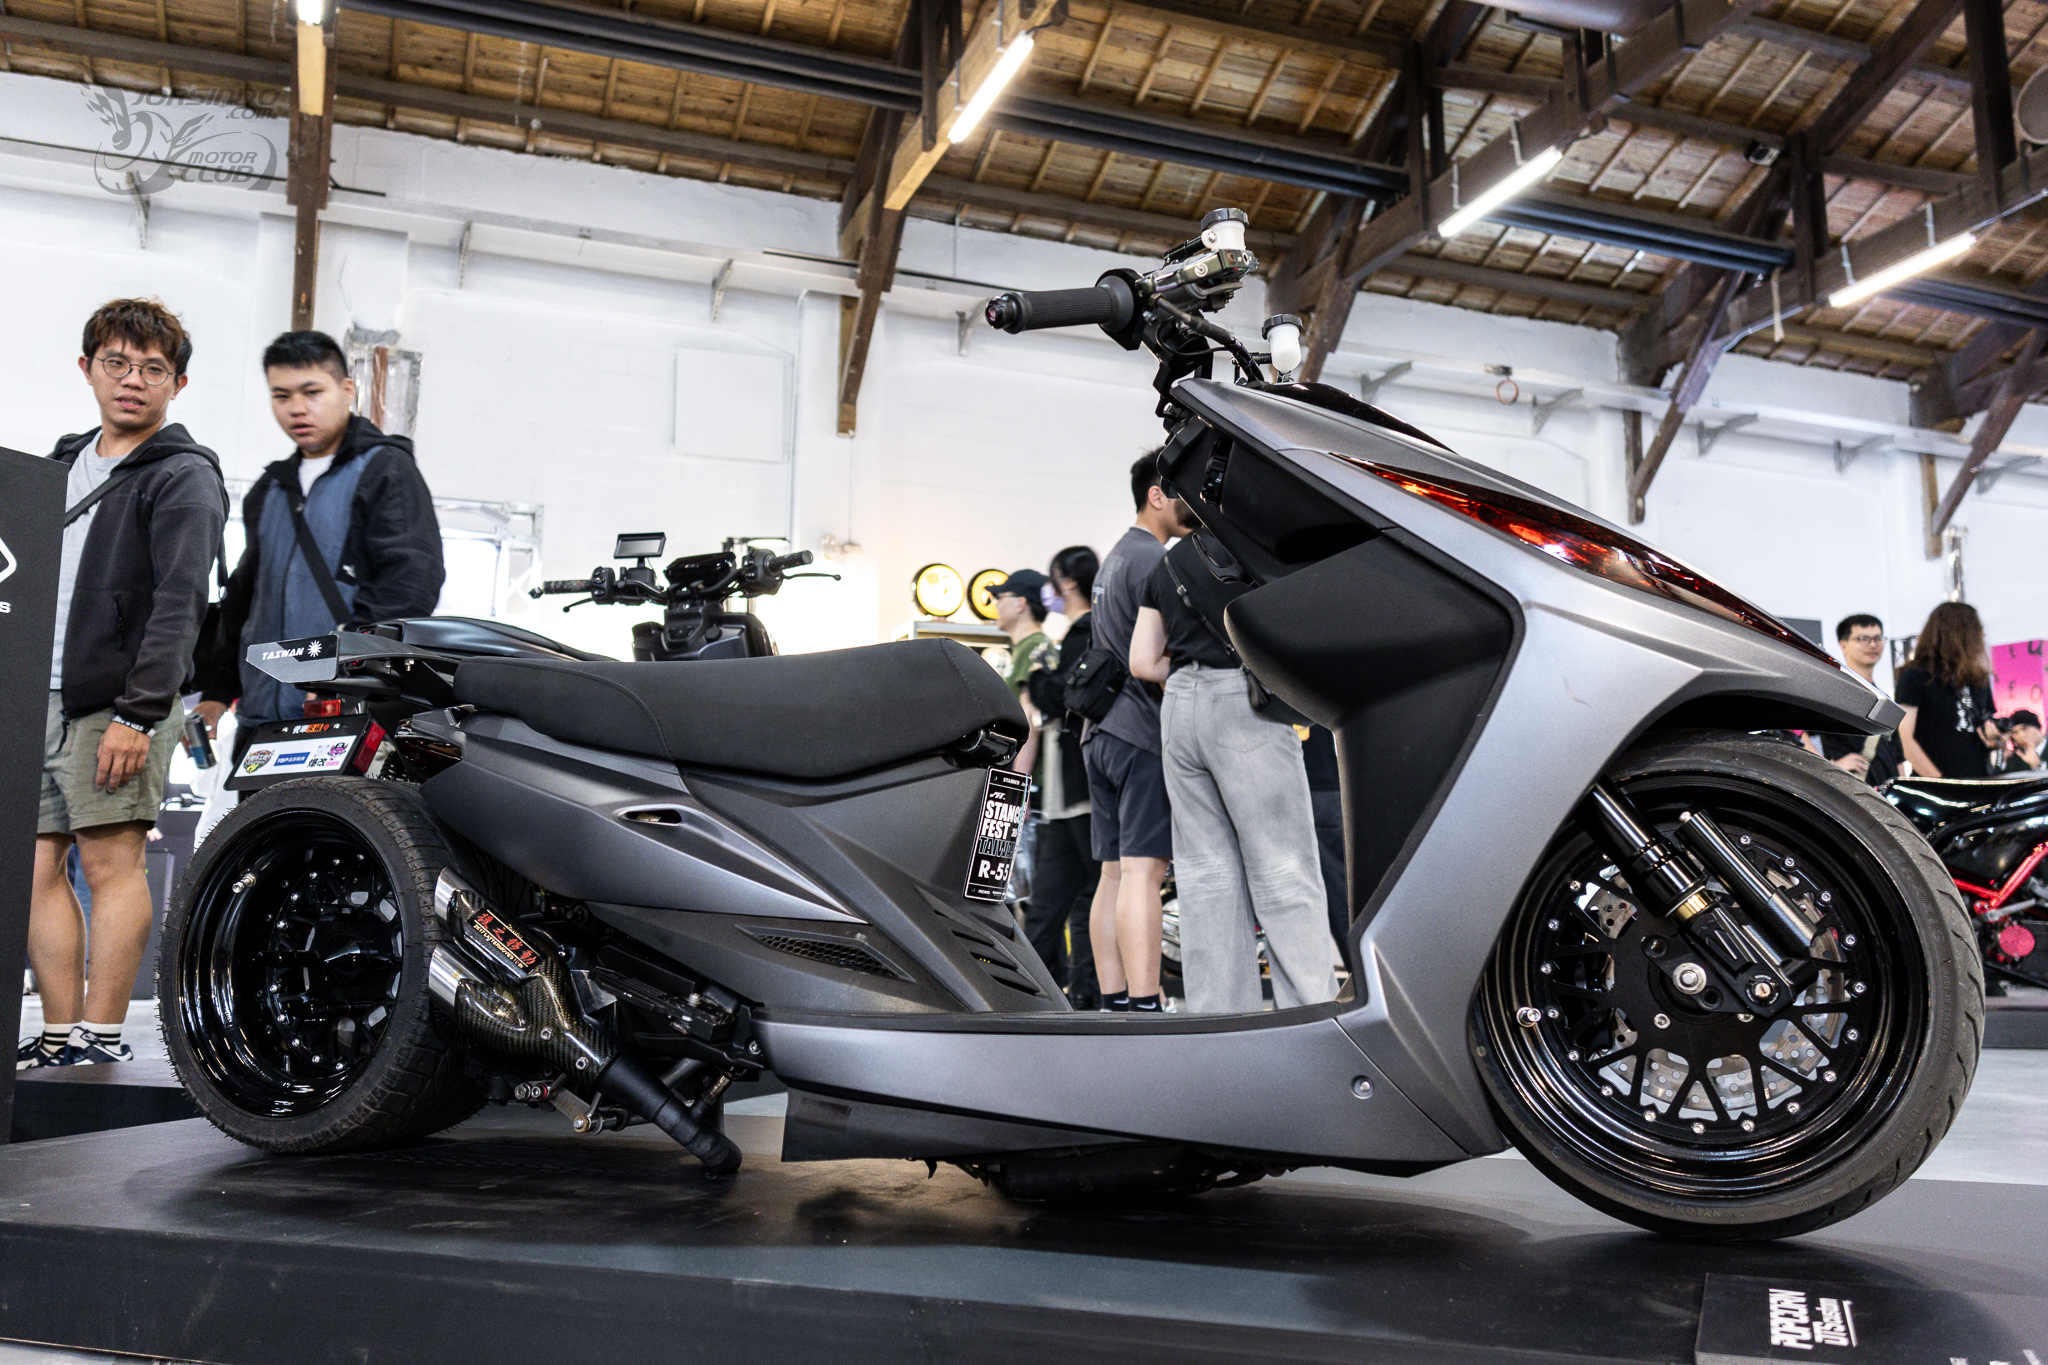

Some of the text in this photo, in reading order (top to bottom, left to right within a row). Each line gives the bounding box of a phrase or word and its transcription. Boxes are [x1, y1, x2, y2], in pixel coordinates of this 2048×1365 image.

[262, 647, 305, 661] TAIWAN
[981, 818, 1011, 839] FEST
[978, 860, 1010, 881] R-55
[1768, 1288, 1814, 1350] POPCORN
